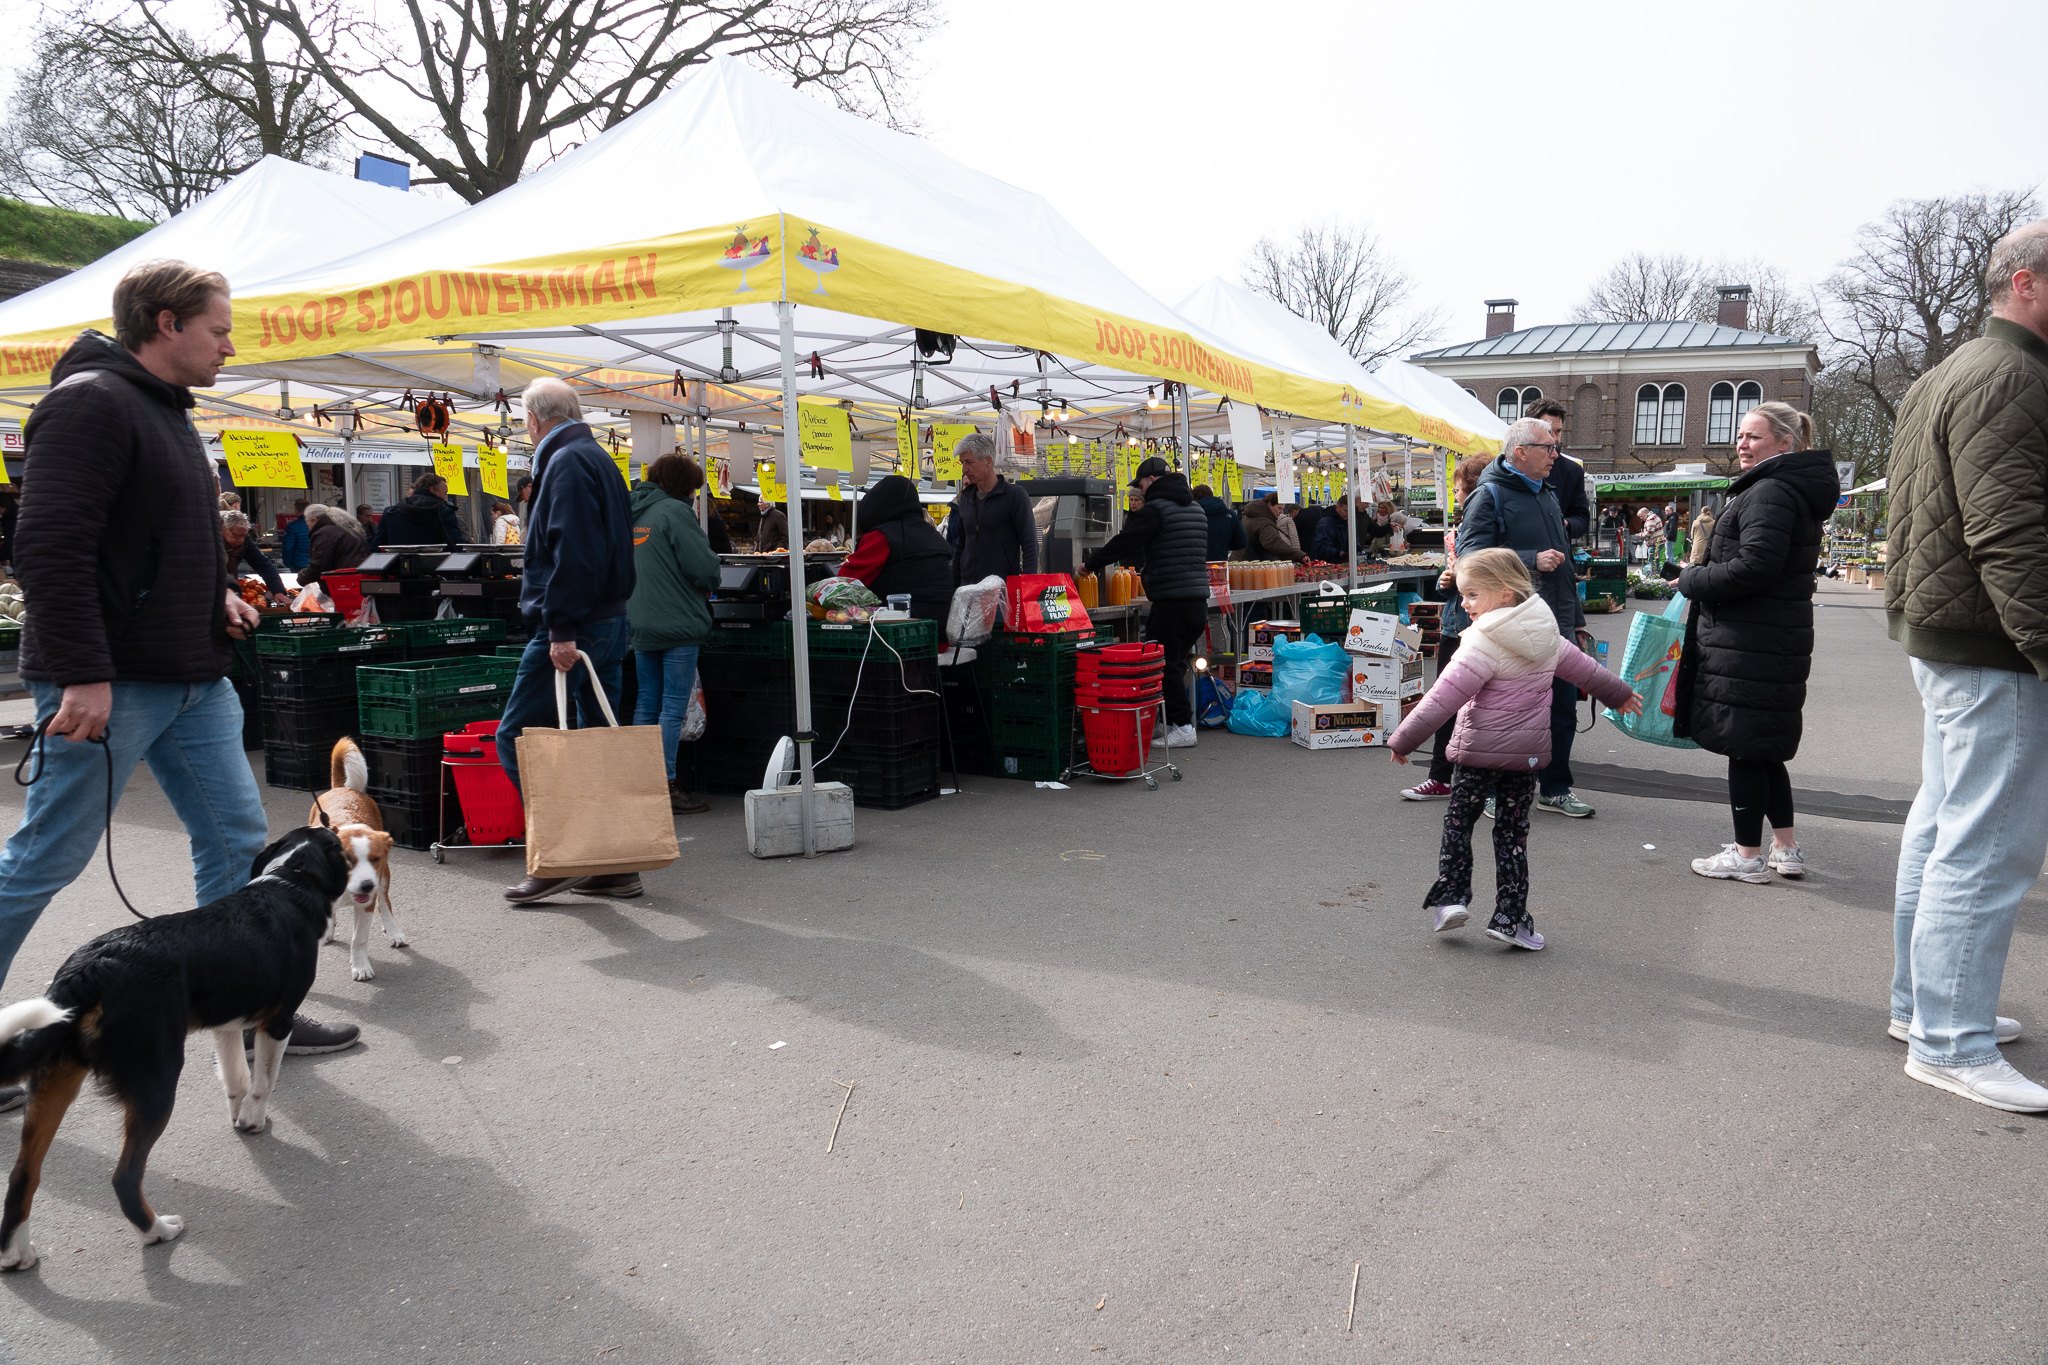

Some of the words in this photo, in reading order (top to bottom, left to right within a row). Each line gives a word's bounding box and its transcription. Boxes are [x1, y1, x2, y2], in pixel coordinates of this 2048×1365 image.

[259, 297, 347, 348] JOOP
[357, 252, 657, 332] SJOUWERMAN
[0, 336, 78, 376] ERM
[1094, 317, 1146, 361] JOOP
[1150, 333, 1253, 395] SJOUWERMAN
[1420, 415, 1434, 437] JOOP
[305, 447, 355, 458] Hollande
[357, 450, 392, 459] nieuwe
[233, 468, 244, 480] 4
[1046, 585, 1067, 594] J'PEUX
[1047, 605, 1070, 613] GRAND
[1348, 637, 1389, 652] Nimbus
[1355, 684, 1397, 695] Nimbus
[1332, 713, 1372, 727] Nimbus
[1318, 734, 1361, 745] Nimbus
[1494, 912, 1511, 925] GAP
